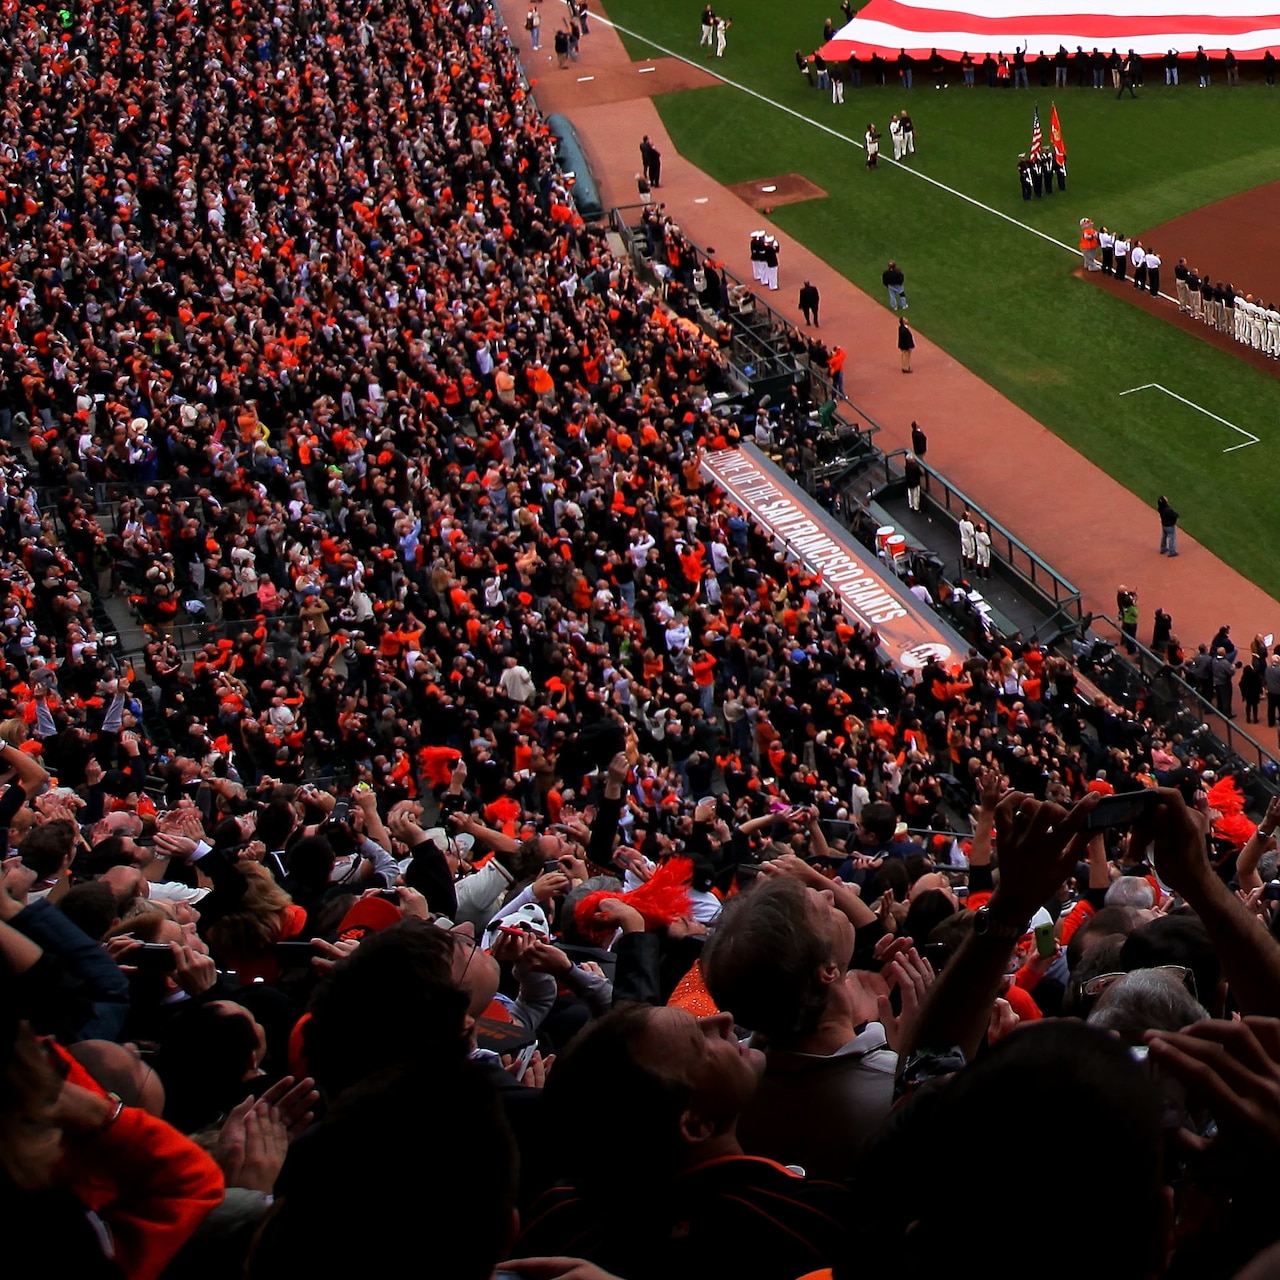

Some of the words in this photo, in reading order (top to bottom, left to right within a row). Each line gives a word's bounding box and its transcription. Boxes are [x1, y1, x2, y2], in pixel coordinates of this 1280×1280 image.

[728, 465, 766, 489] OF
[741, 480, 783, 505] THE
[757, 499, 805, 531] SAN
[779, 519, 865, 583] FRANCISCO
[839, 577, 908, 624] GIANTS
